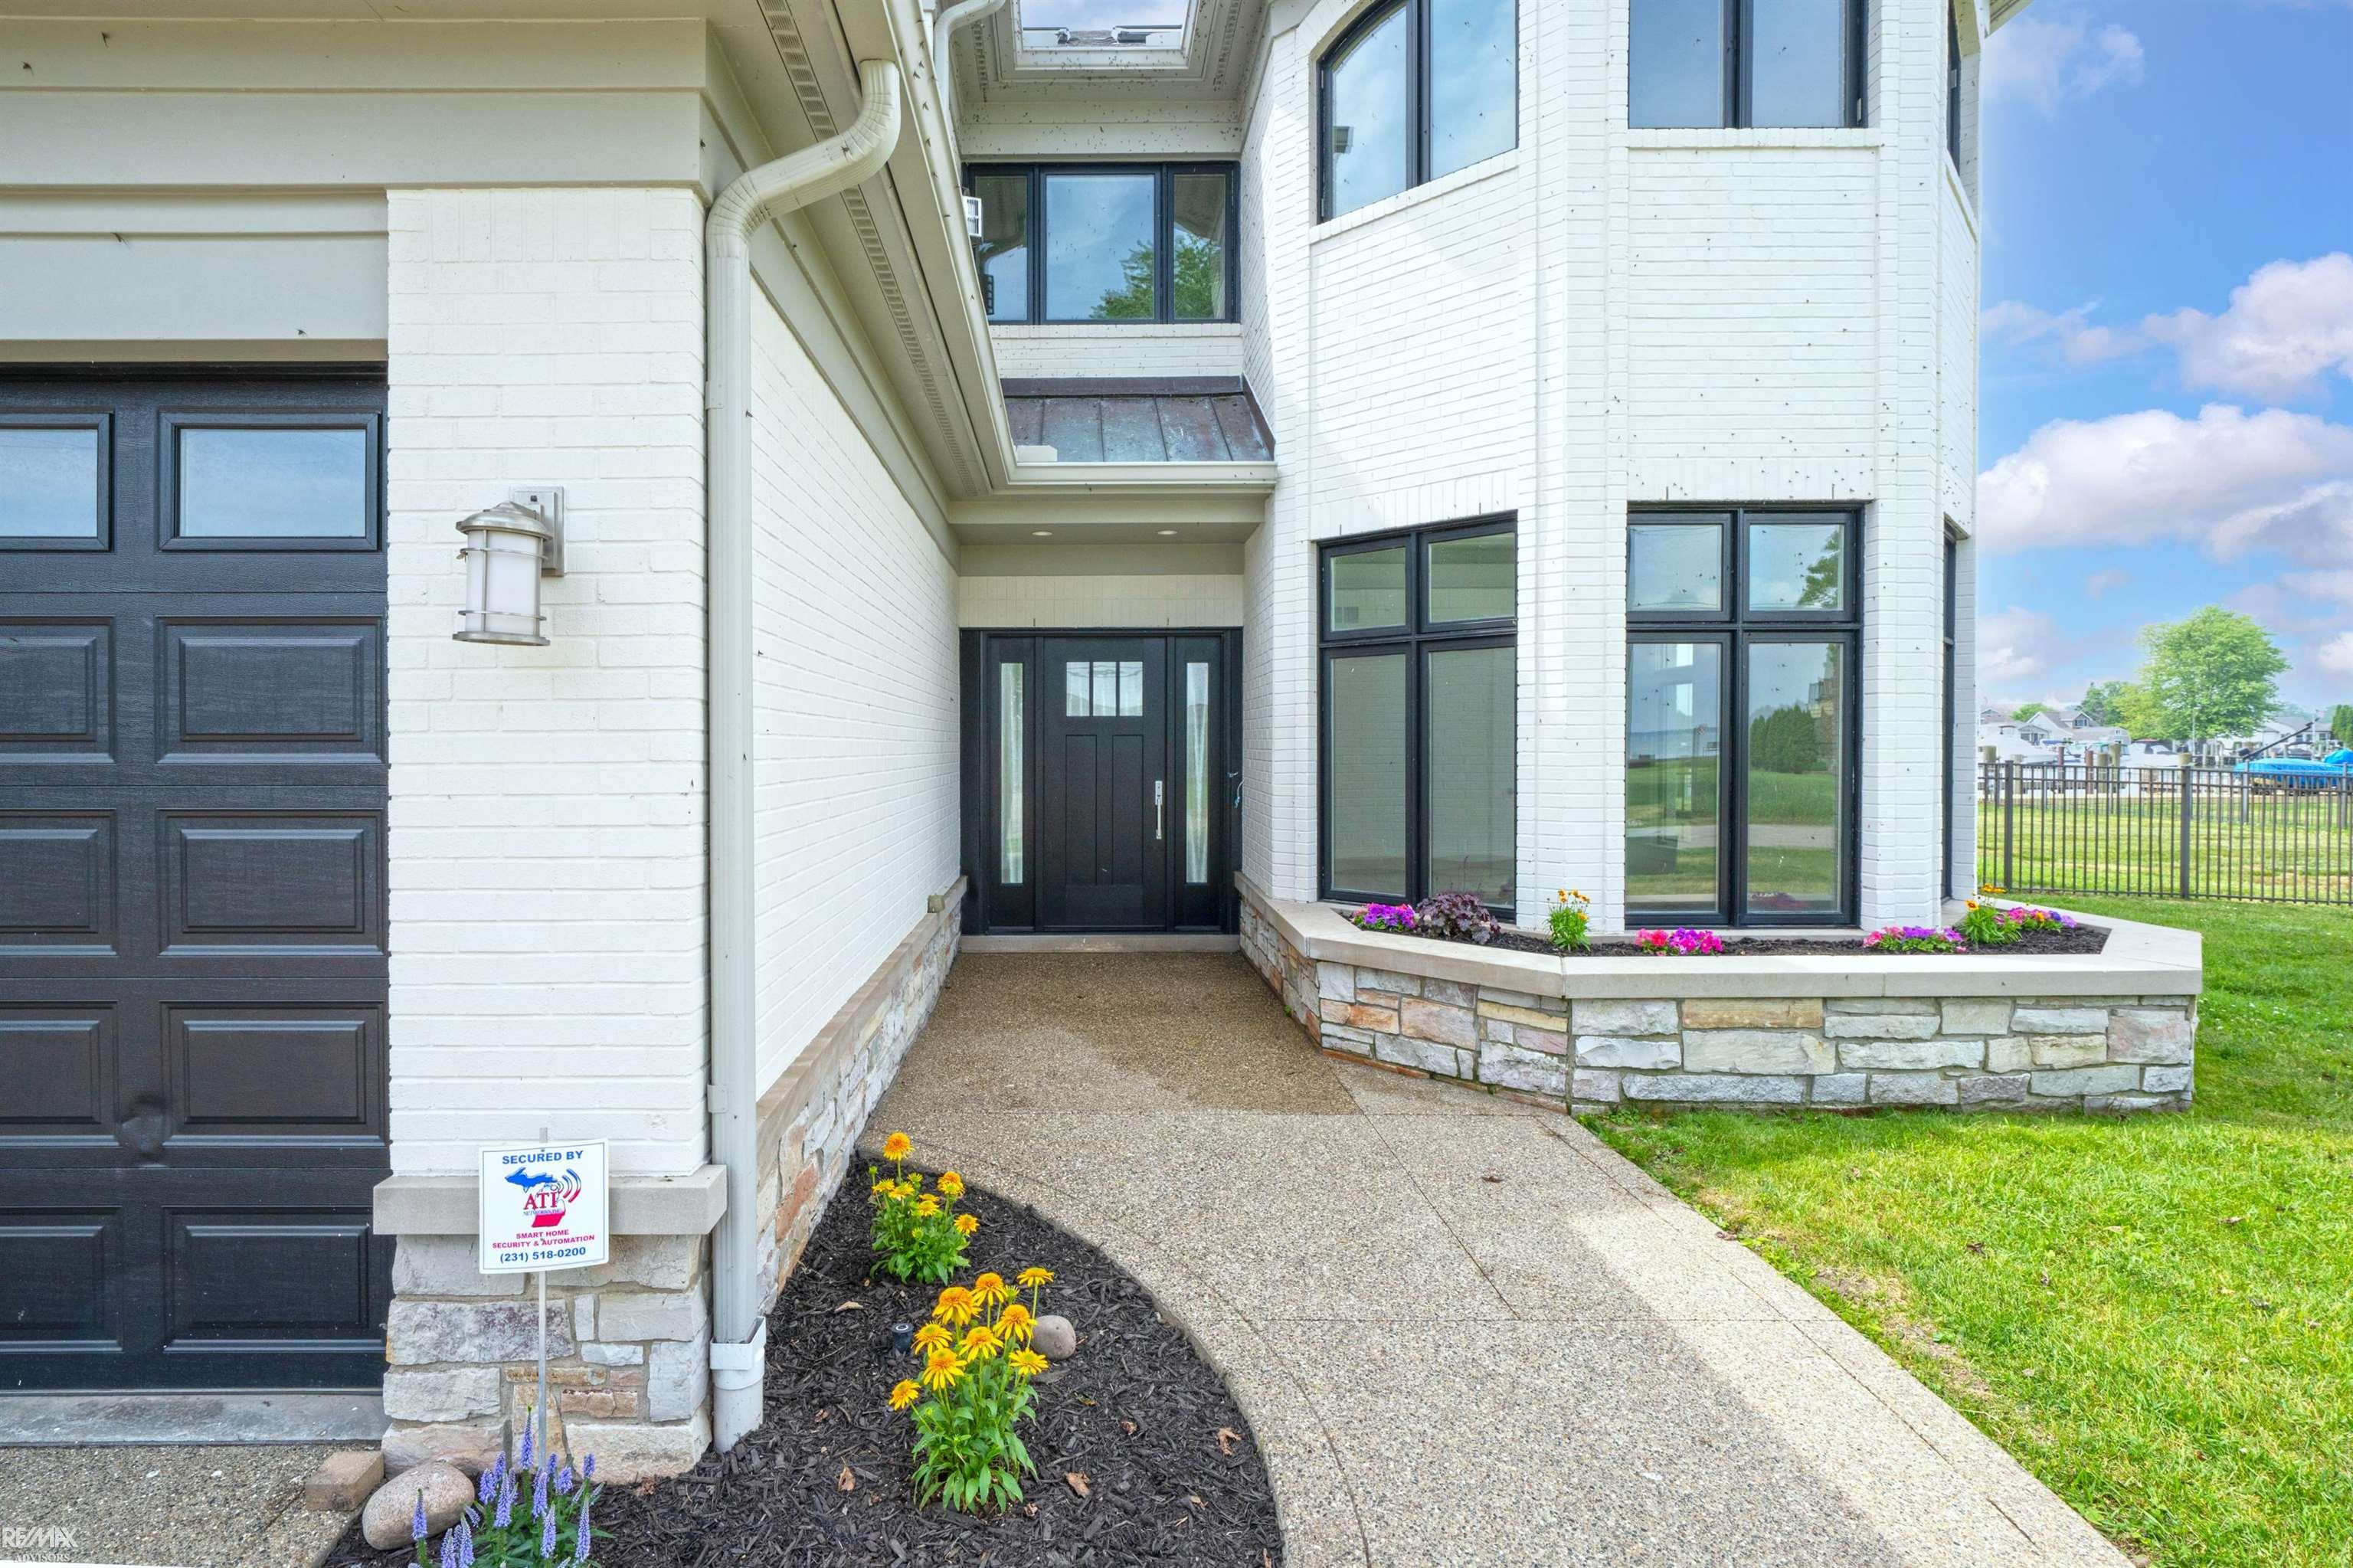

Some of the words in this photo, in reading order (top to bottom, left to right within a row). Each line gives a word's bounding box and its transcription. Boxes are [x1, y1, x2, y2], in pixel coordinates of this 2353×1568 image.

[502, 1154, 561, 1165] SECURED
[566, 1151, 583, 1160] BY
[523, 1192, 558, 1210] ATI
[542, 1234, 595, 1246] AUTOMATION
[545, 1229, 569, 1237] HOME
[500, 1252, 529, 1264] (231)
[532, 1246, 587, 1260] 518-0200
